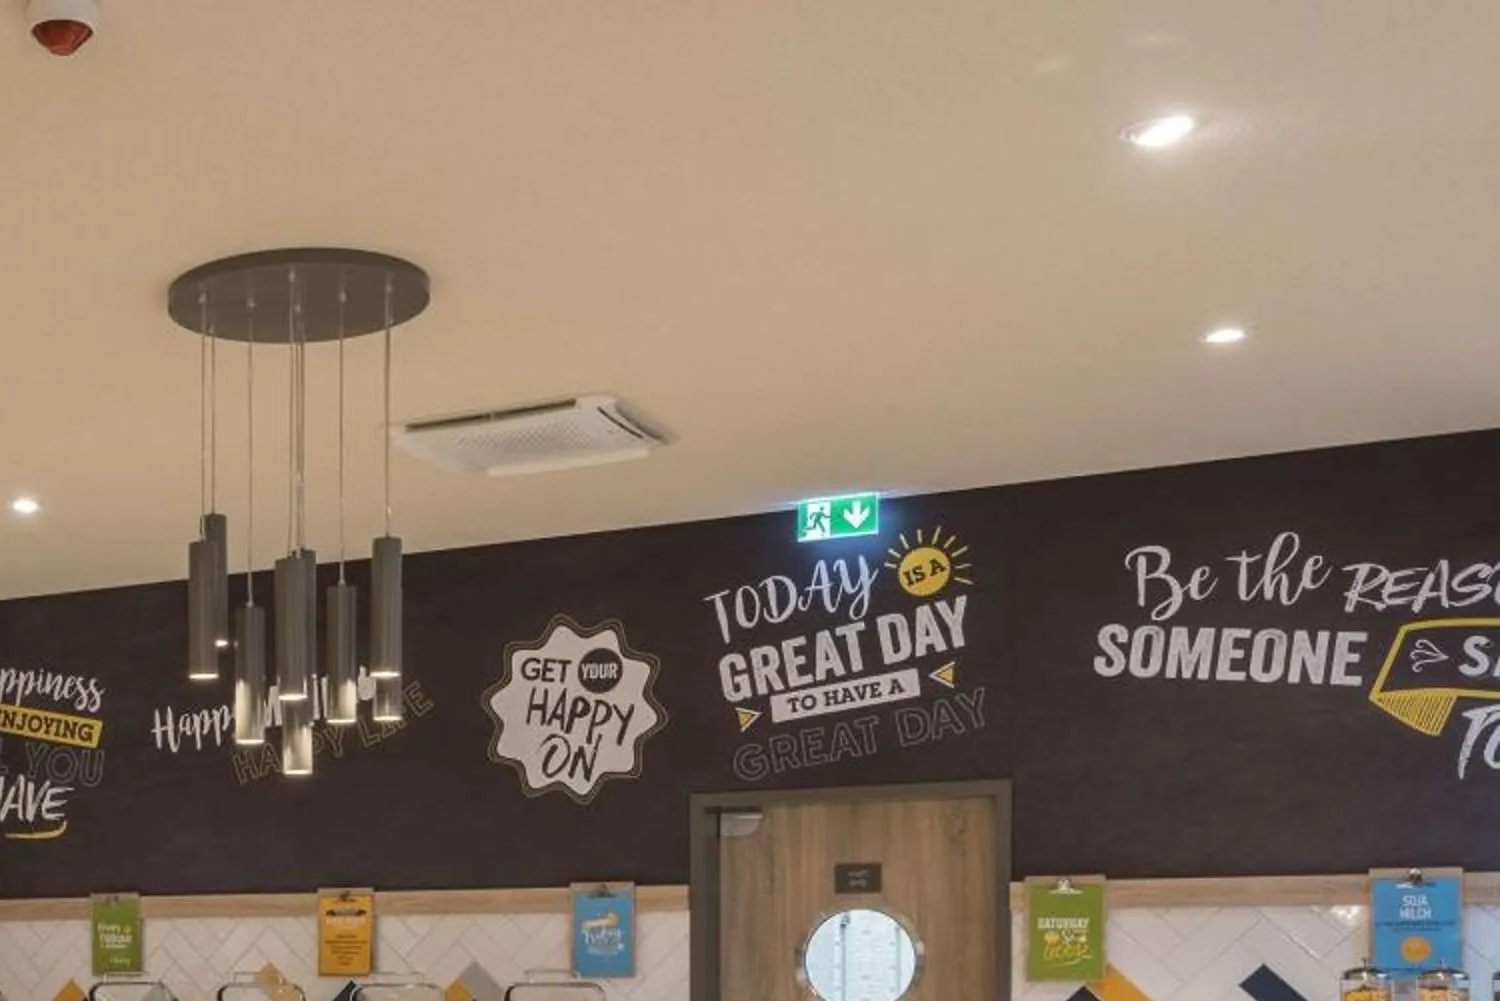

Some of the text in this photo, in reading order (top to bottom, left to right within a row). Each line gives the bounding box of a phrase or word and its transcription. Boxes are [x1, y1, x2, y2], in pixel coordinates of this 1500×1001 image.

[702, 555, 881, 645] TODAY
[902, 557, 948, 588] IS A
[1124, 544, 1219, 621] Be
[1225, 531, 1332, 607] the
[521, 656, 621, 685] GET YOUR
[718, 595, 969, 703] GREAT DAY
[1093, 623, 1369, 688] SOMEONE
[525, 687, 636, 747] HAPPY
[787, 676, 907, 715] TO HAVE A
[151, 704, 238, 753] Happ
[731, 687, 988, 783] GREAT DAY
[24, 740, 106, 788] YOU
[541, 733, 604, 784] ON
